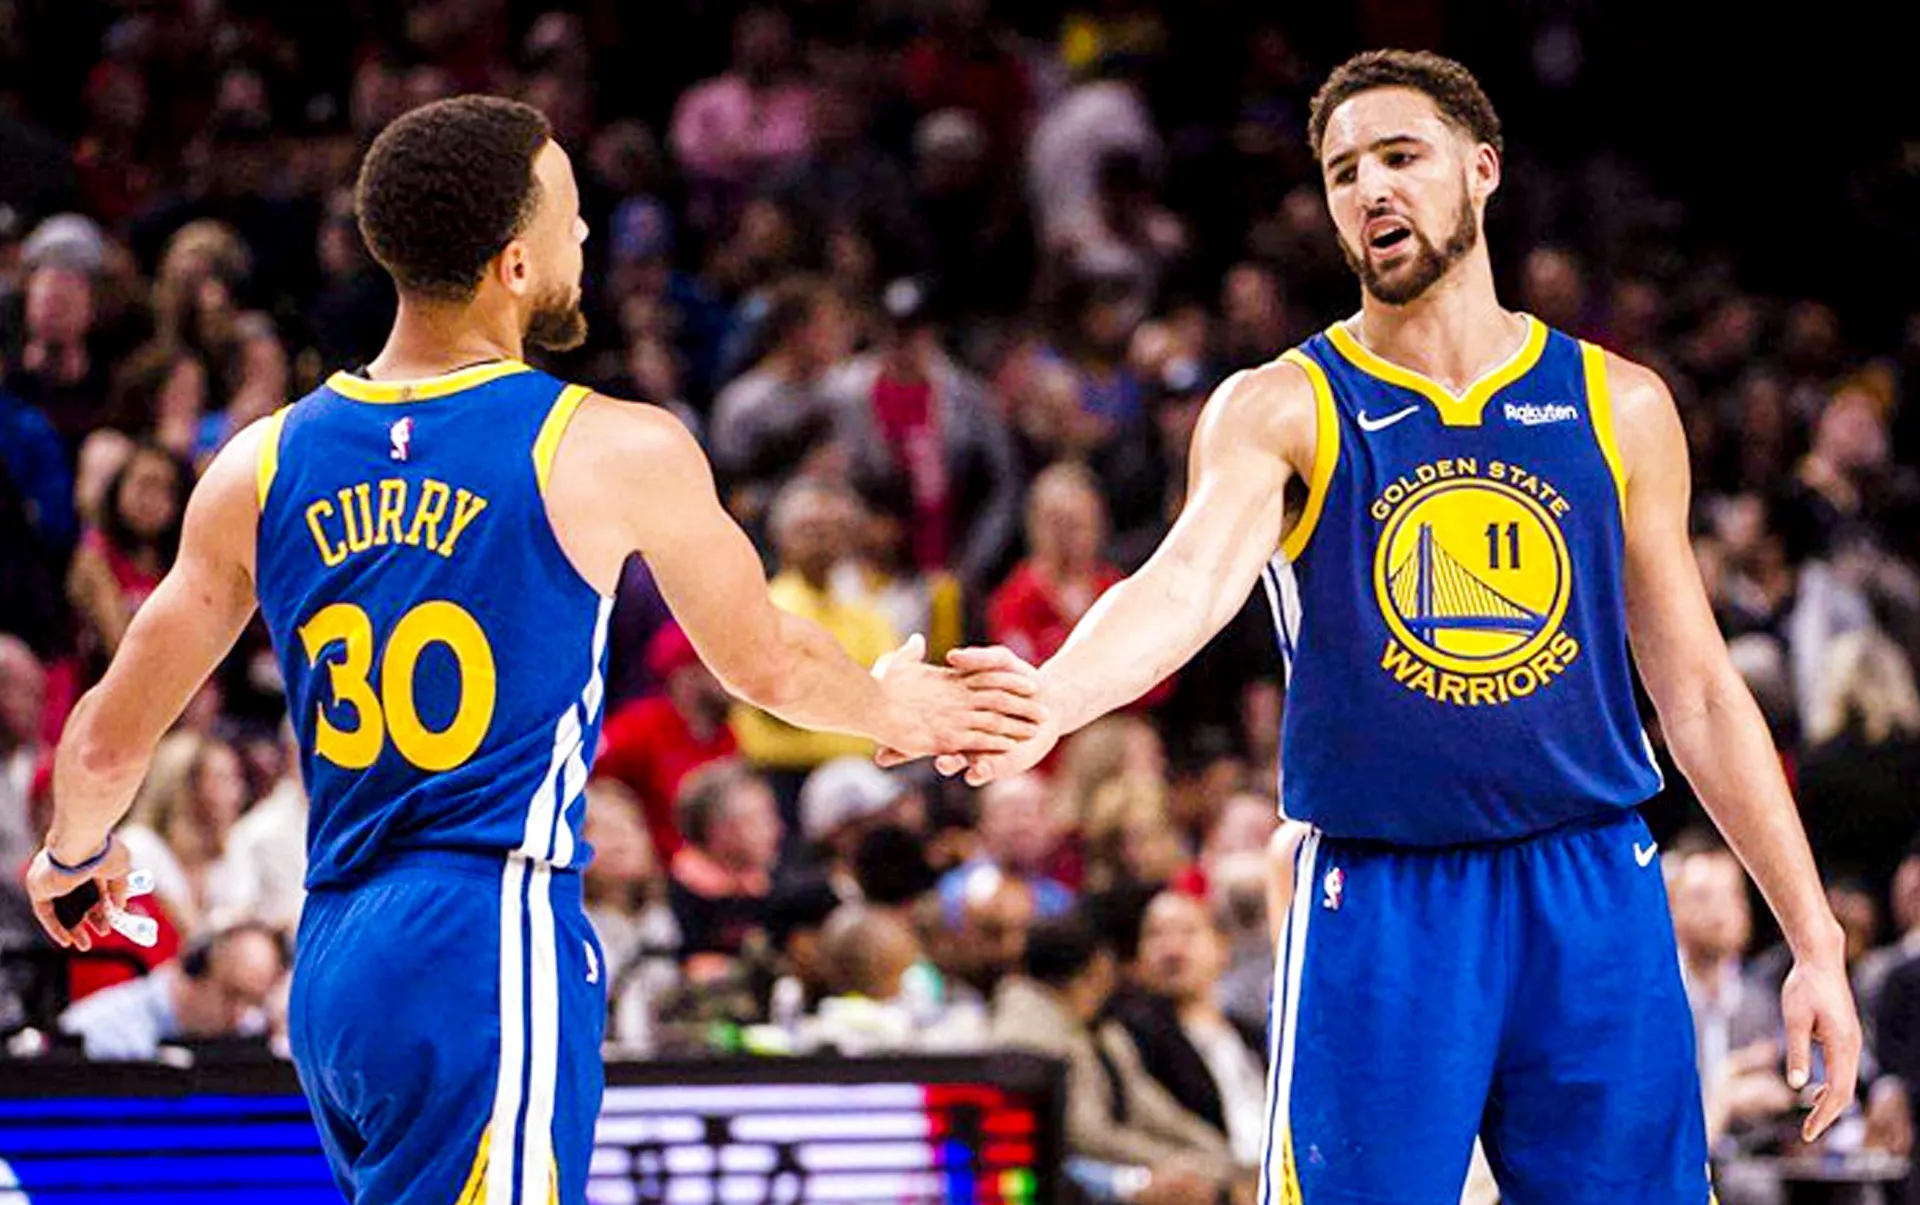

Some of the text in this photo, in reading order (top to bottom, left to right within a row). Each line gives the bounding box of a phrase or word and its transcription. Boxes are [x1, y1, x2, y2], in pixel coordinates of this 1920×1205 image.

[1503, 403, 1578, 423] Rakuten
[305, 478, 488, 567] CURRY
[1371, 458, 1570, 520] GOLDEN STATE
[1484, 522, 1522, 570] 11
[298, 599, 496, 771] 30
[1380, 631, 1581, 706] WARRIORS
